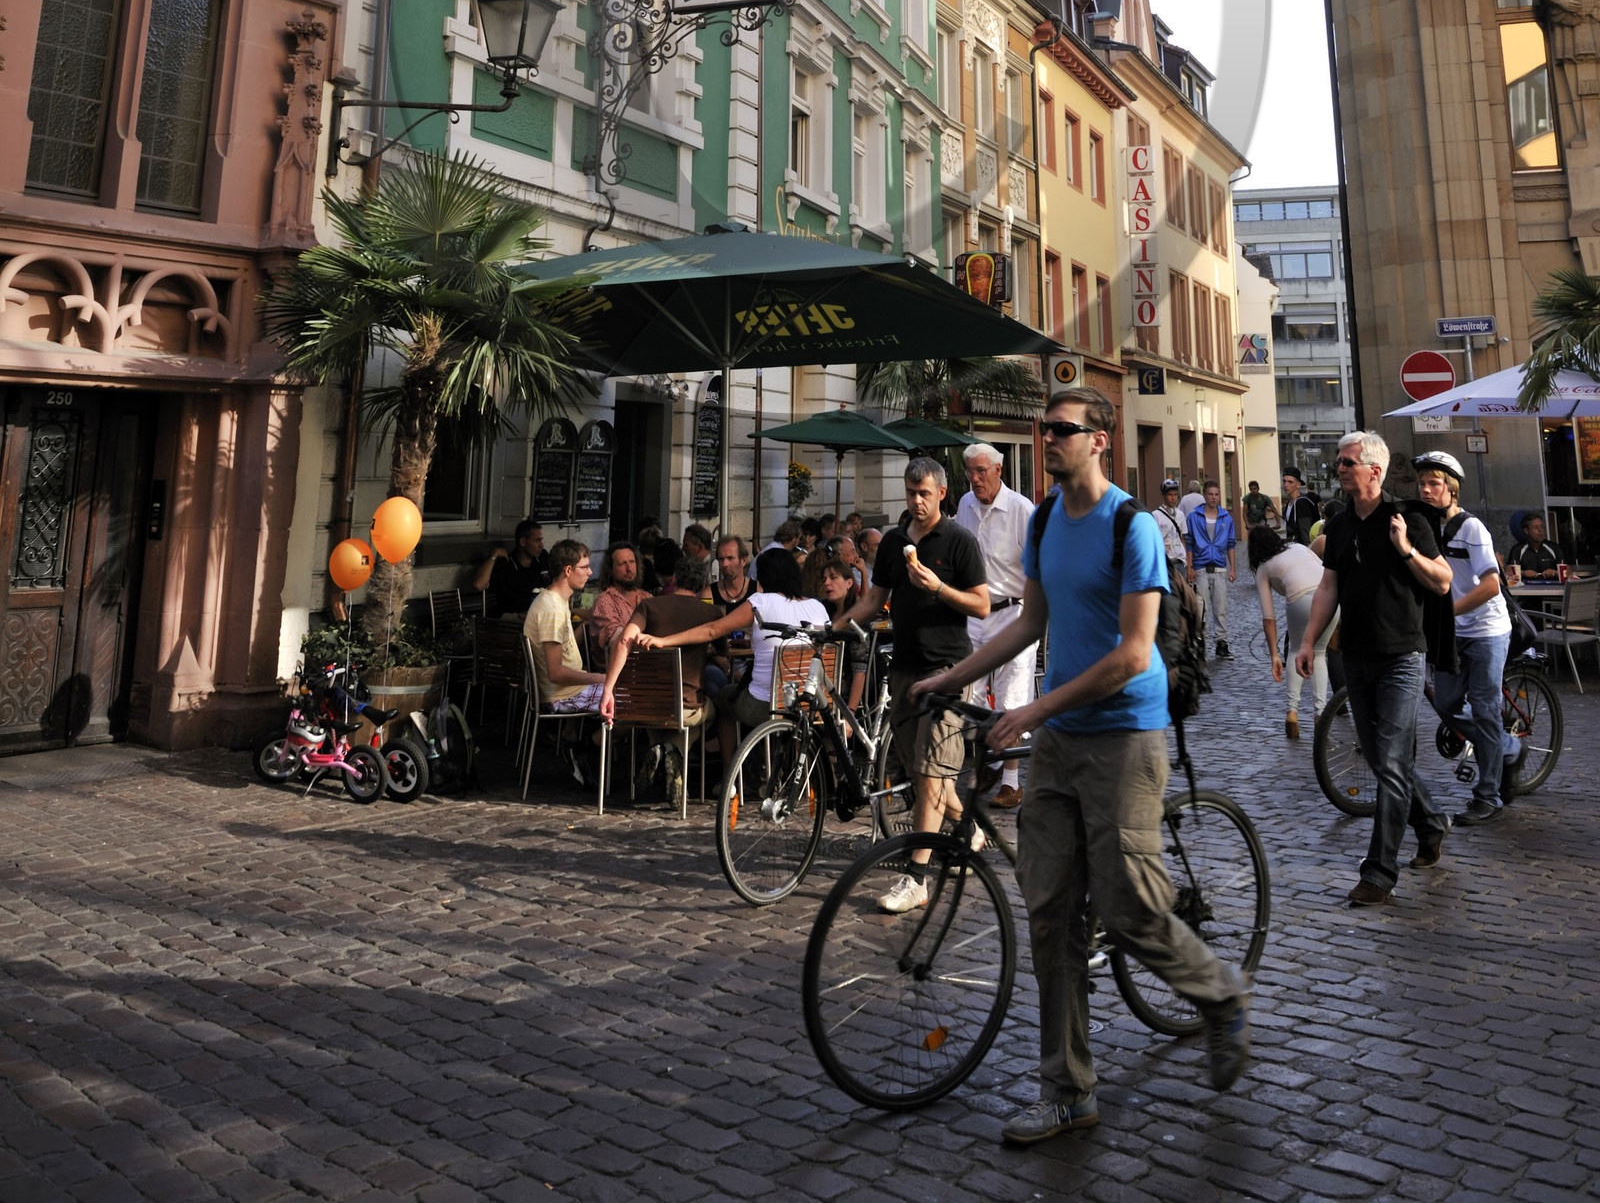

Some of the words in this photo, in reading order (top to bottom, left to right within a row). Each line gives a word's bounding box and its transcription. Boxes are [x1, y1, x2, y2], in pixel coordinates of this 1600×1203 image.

[1131, 146, 1157, 325] CASINO
[573, 253, 717, 275] JEVER
[994, 255, 1004, 295] KEBAP
[46, 391, 73, 406] 250
